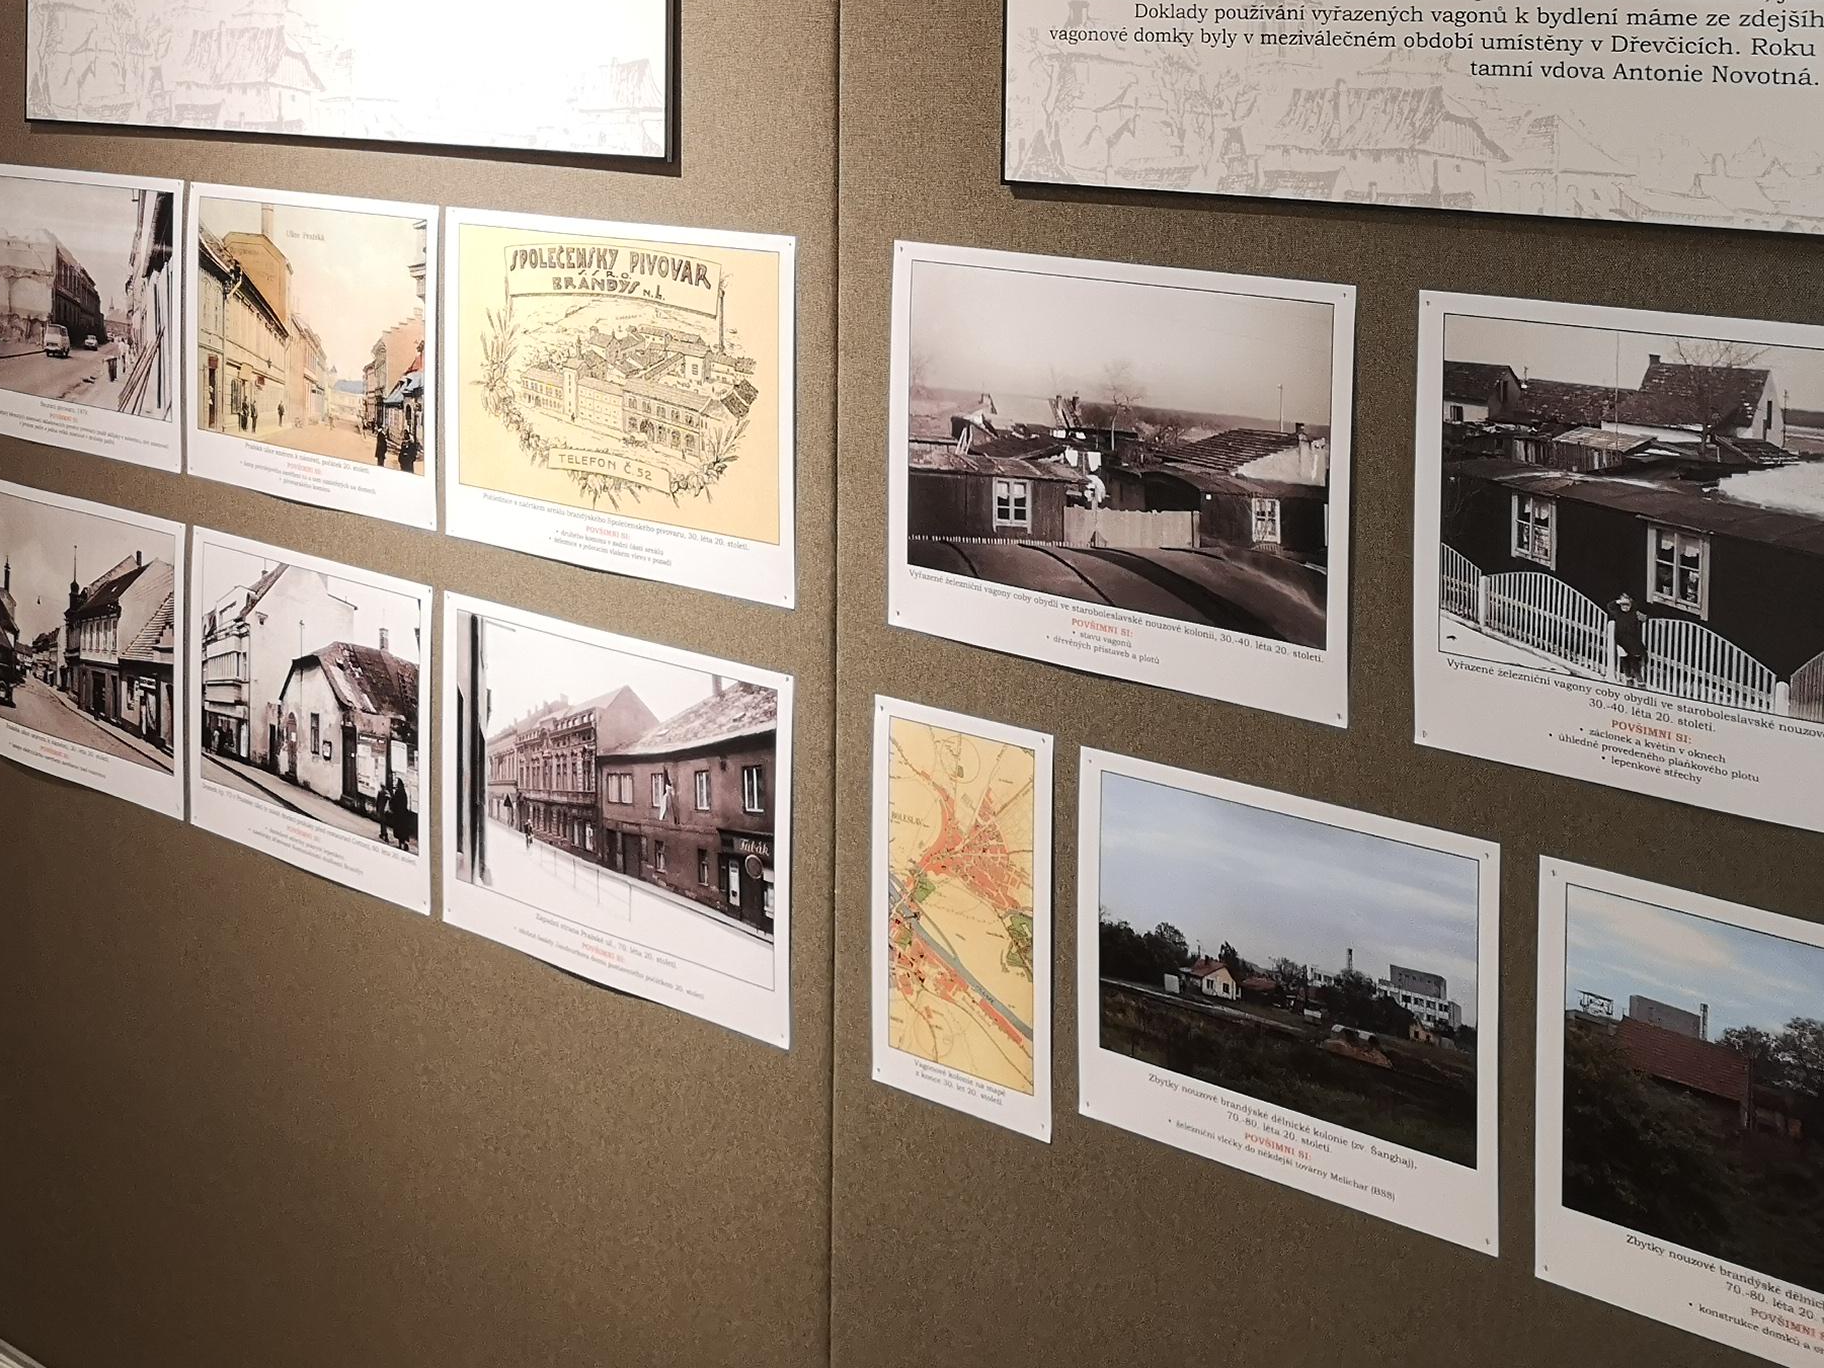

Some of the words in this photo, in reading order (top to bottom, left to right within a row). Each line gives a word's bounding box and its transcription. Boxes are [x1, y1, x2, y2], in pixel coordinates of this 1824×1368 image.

[1470, 61, 1533, 78] tamní
[1540, 60, 1606, 80] vdova
[1612, 63, 1703, 83] Antonie
[1712, 65, 1819, 86] Novotná.
[629, 250, 712, 290] PIVOVAR
[558, 453, 617, 471] TELEFON
